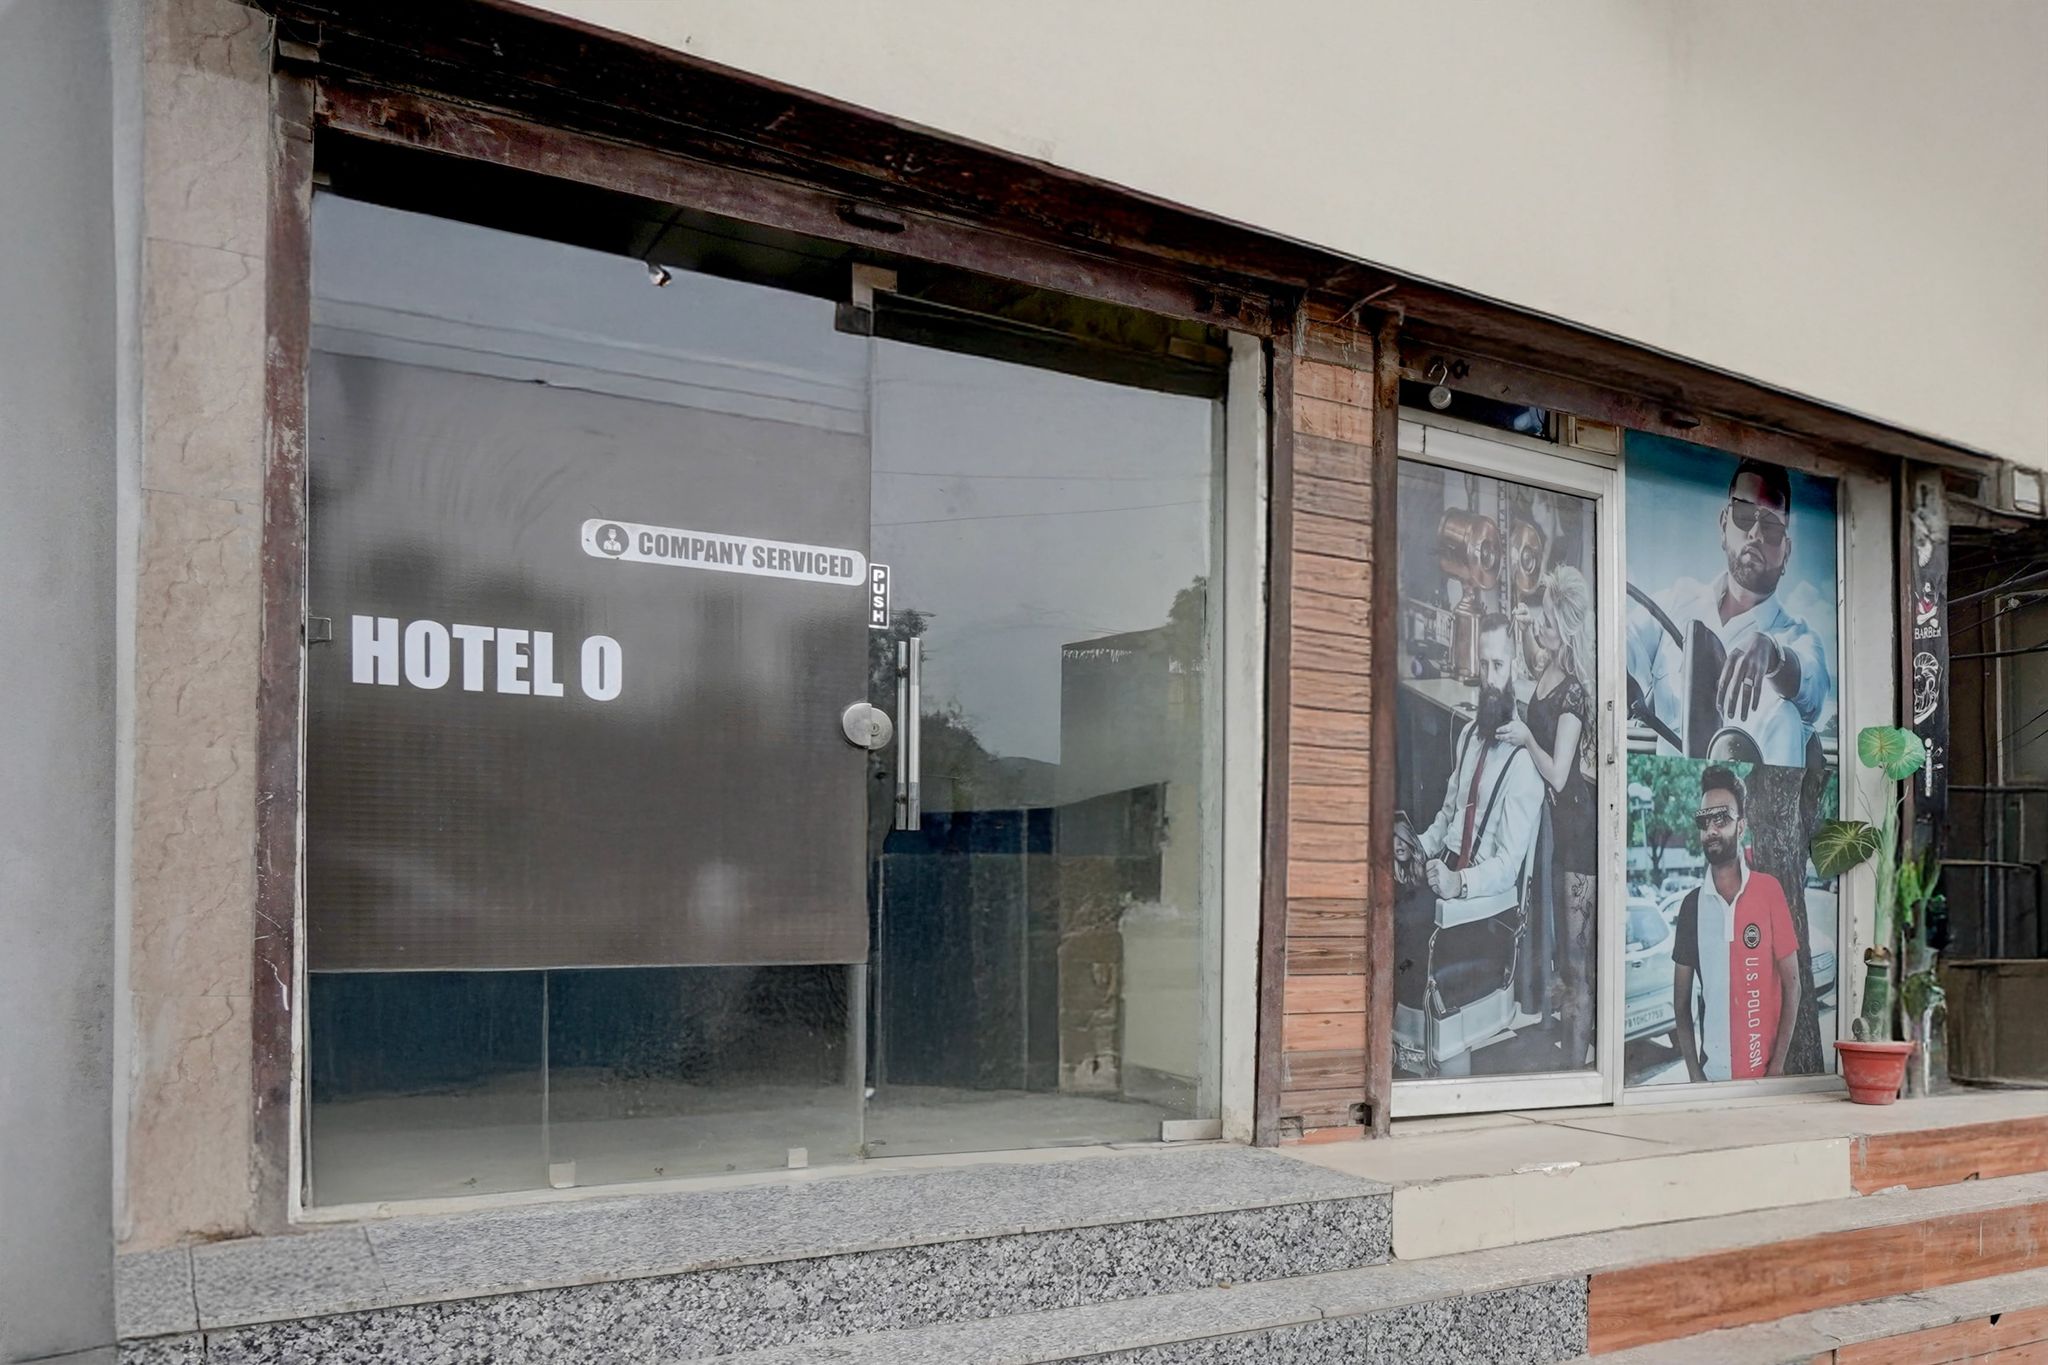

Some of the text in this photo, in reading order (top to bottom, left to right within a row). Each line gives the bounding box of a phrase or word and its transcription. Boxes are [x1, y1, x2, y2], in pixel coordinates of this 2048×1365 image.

[638, 531, 853, 578] COMPANY SERVICED
[873, 569, 885, 623] PUSH
[352, 615, 622, 701] HOTEL O
[1914, 626, 1942, 640] BARBER
[1745, 957, 1763, 1072] U.S. POLO ASSN.
